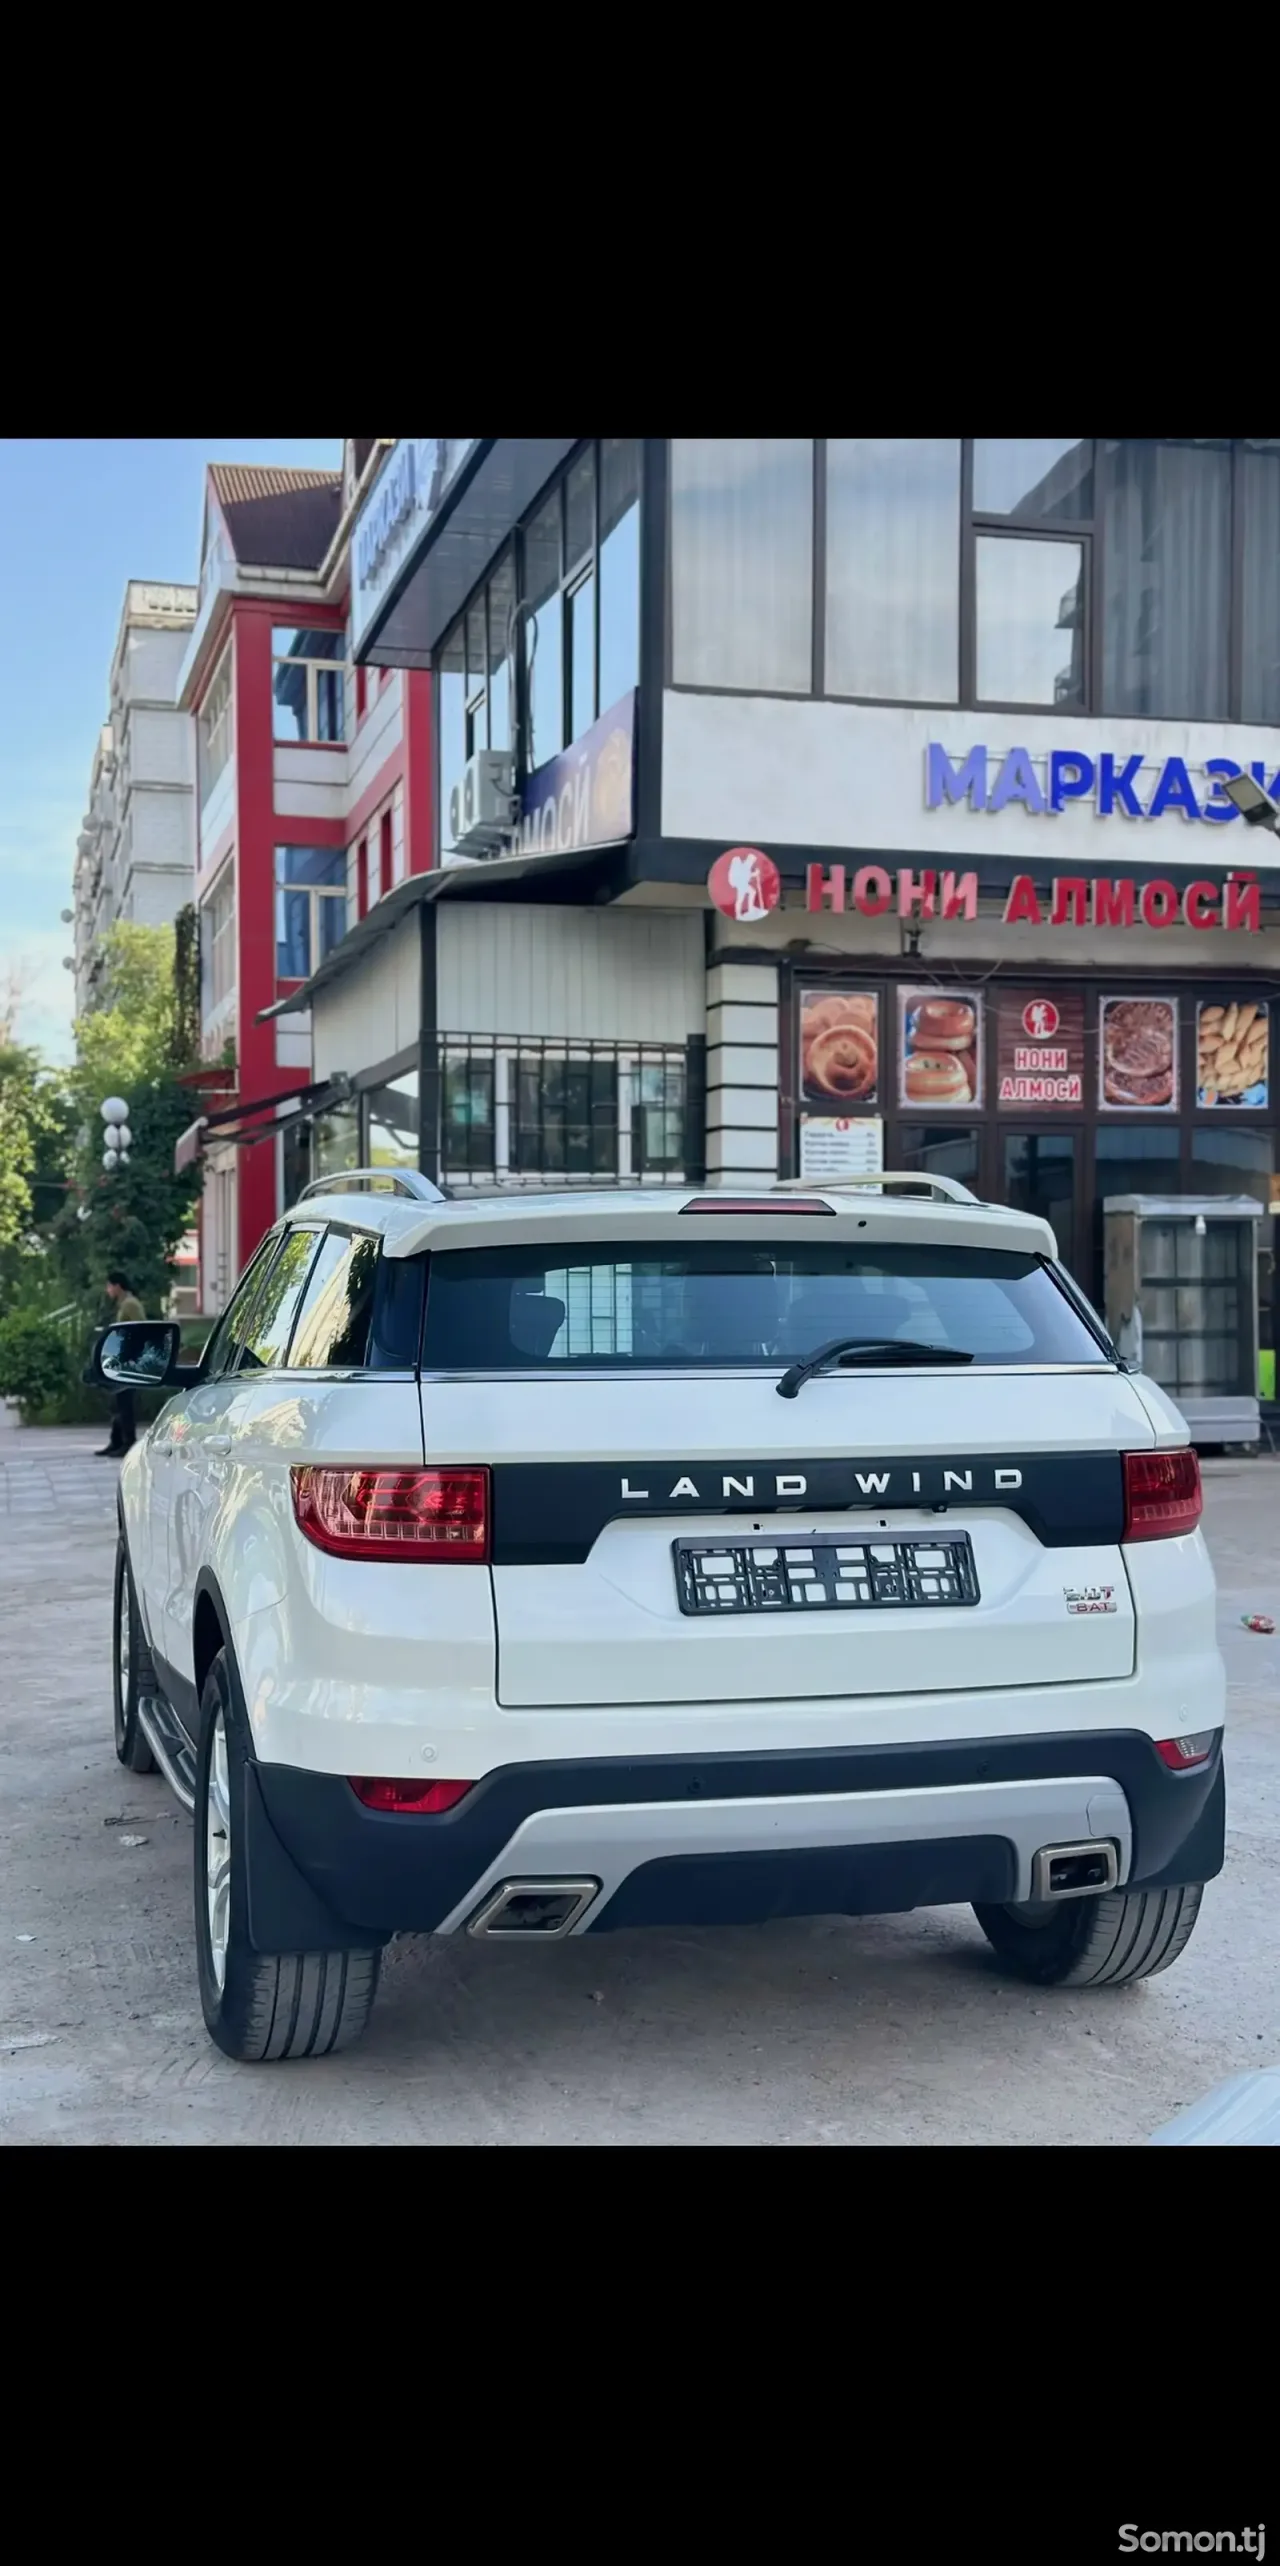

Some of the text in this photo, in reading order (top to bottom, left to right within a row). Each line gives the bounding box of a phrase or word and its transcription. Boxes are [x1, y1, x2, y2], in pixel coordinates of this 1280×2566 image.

[806, 862, 978, 921] НОНИ
[1015, 1048, 1067, 1070] НОНИ
[621, 1468, 1023, 1499] LAND WIND
